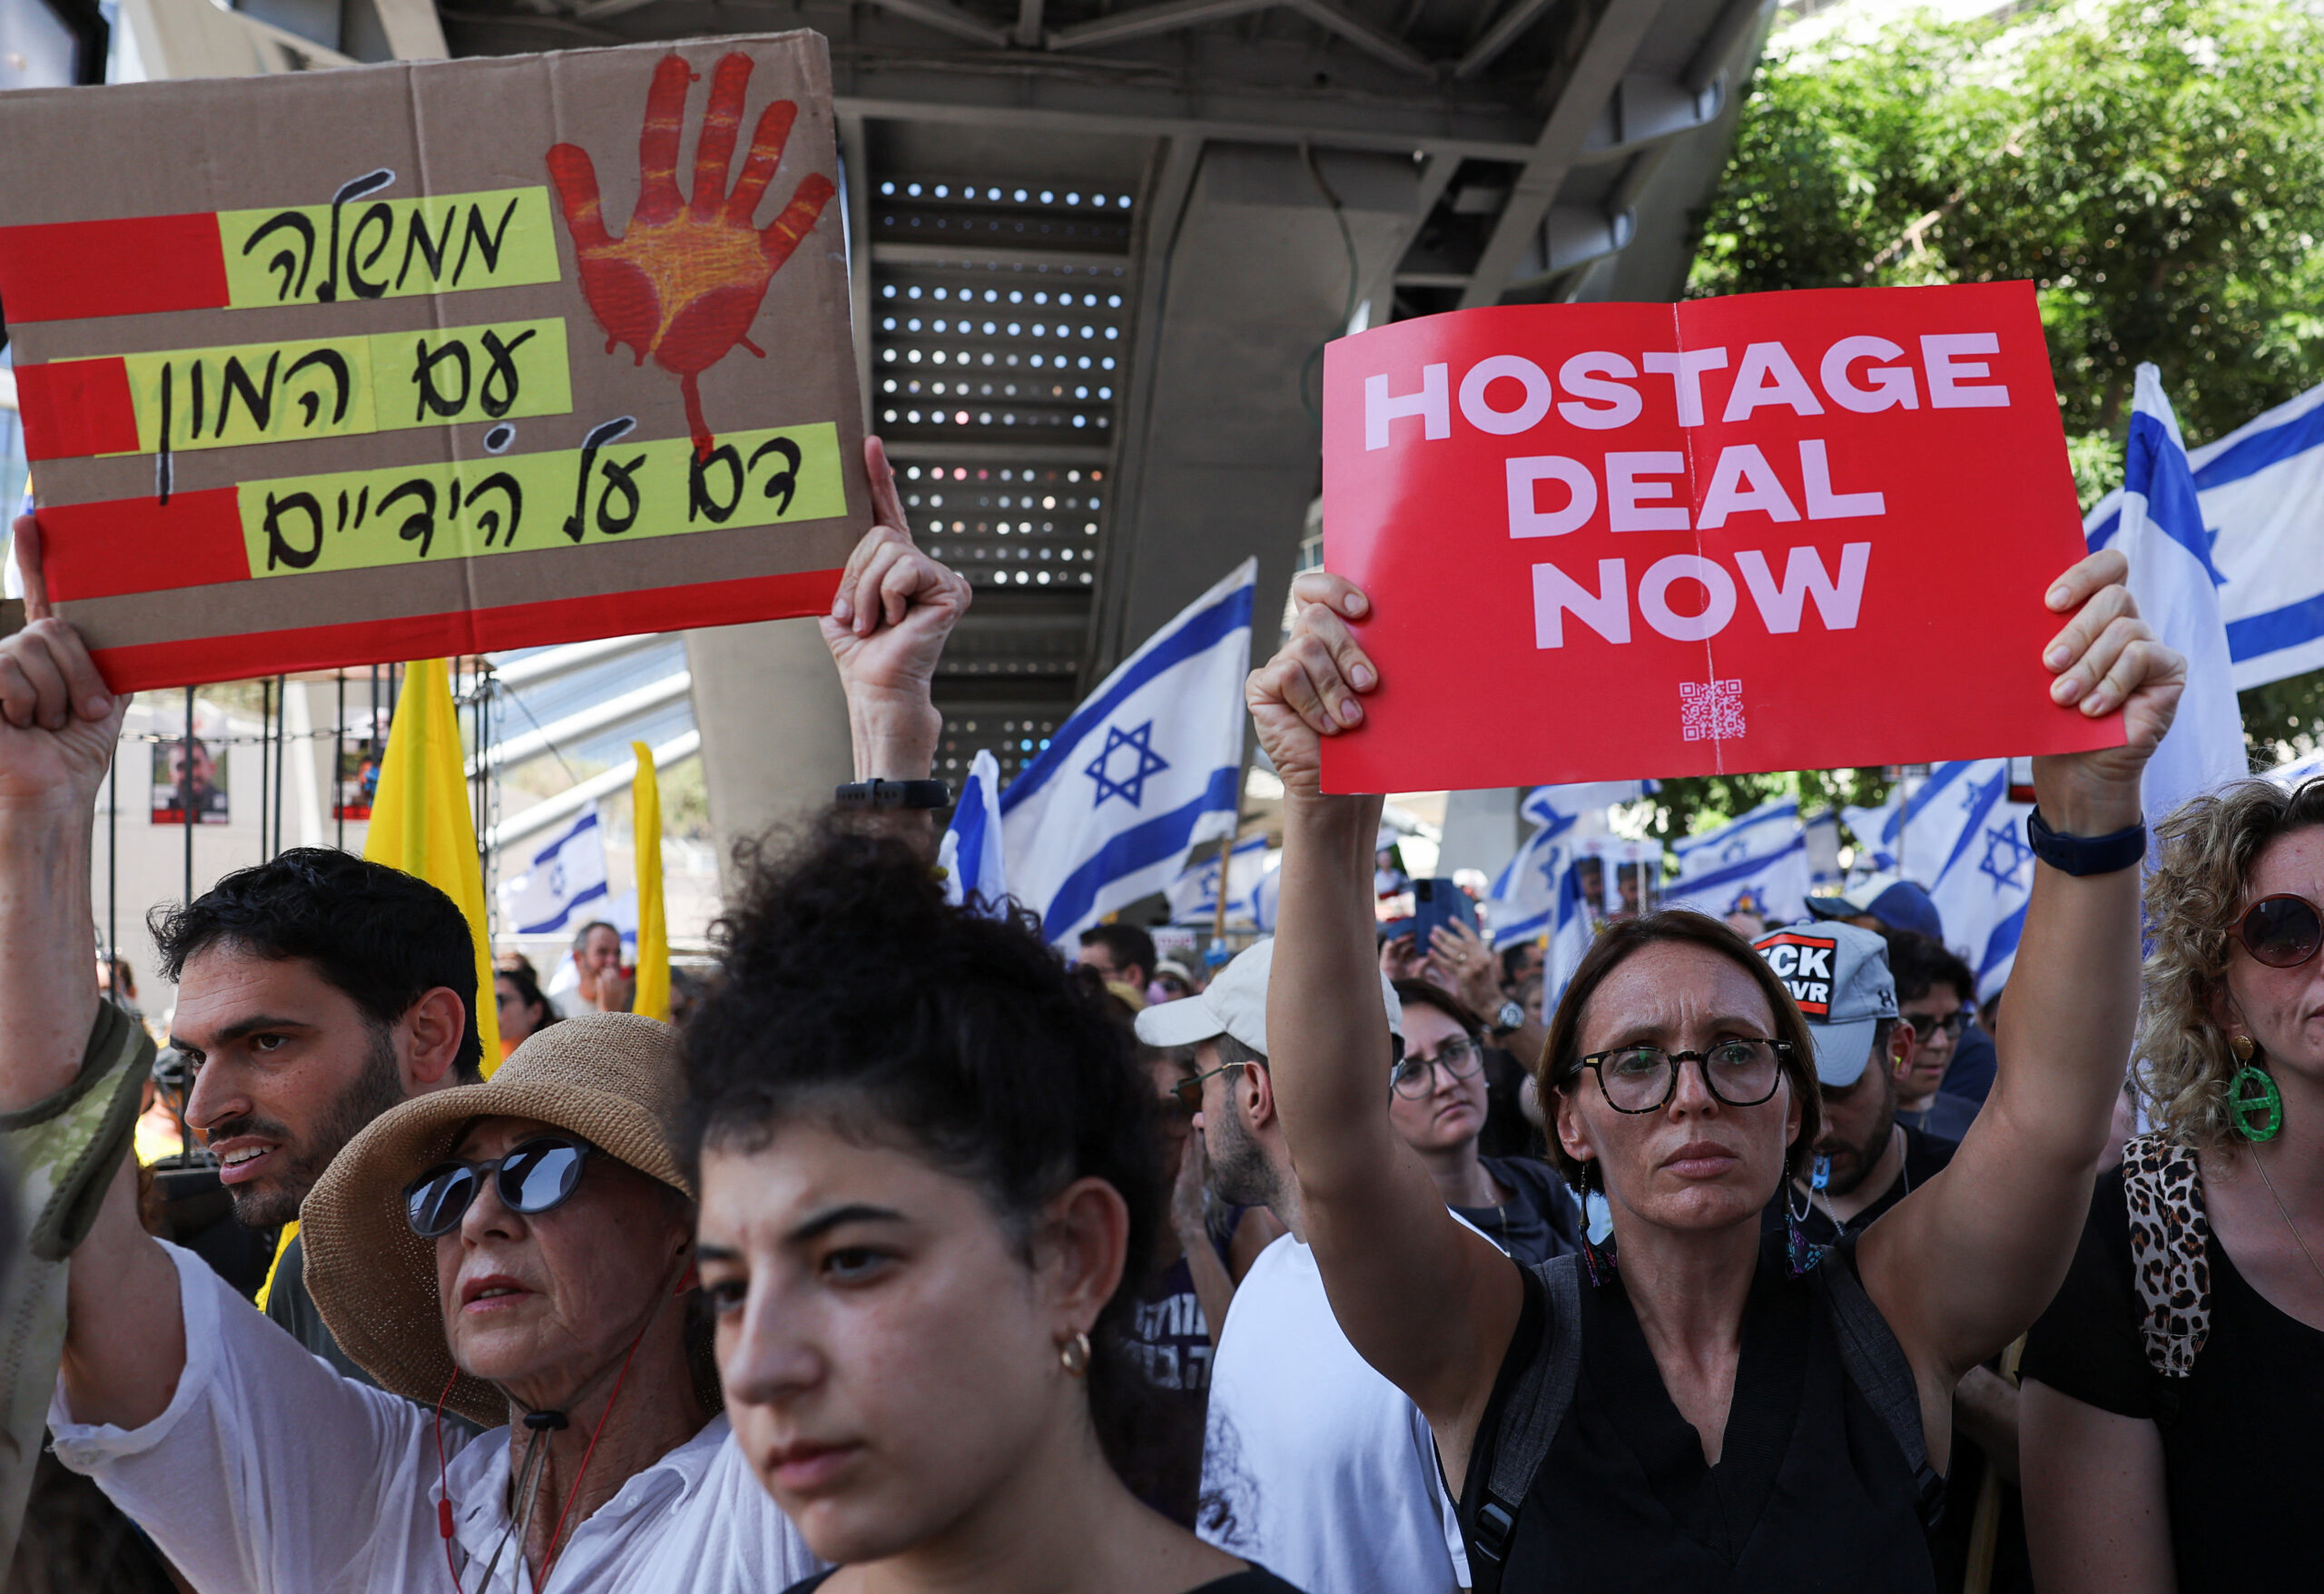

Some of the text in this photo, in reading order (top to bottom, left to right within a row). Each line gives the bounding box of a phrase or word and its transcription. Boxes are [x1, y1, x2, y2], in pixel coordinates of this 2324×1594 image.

[242, 170, 518, 304] ממשלה
[159, 348, 350, 507] המון
[1364, 332, 2011, 451] HOSTAGE
[262, 418, 802, 571] דם על הידיים
[1505, 438, 1886, 540] DEAL
[1531, 541, 1872, 650] NOW
